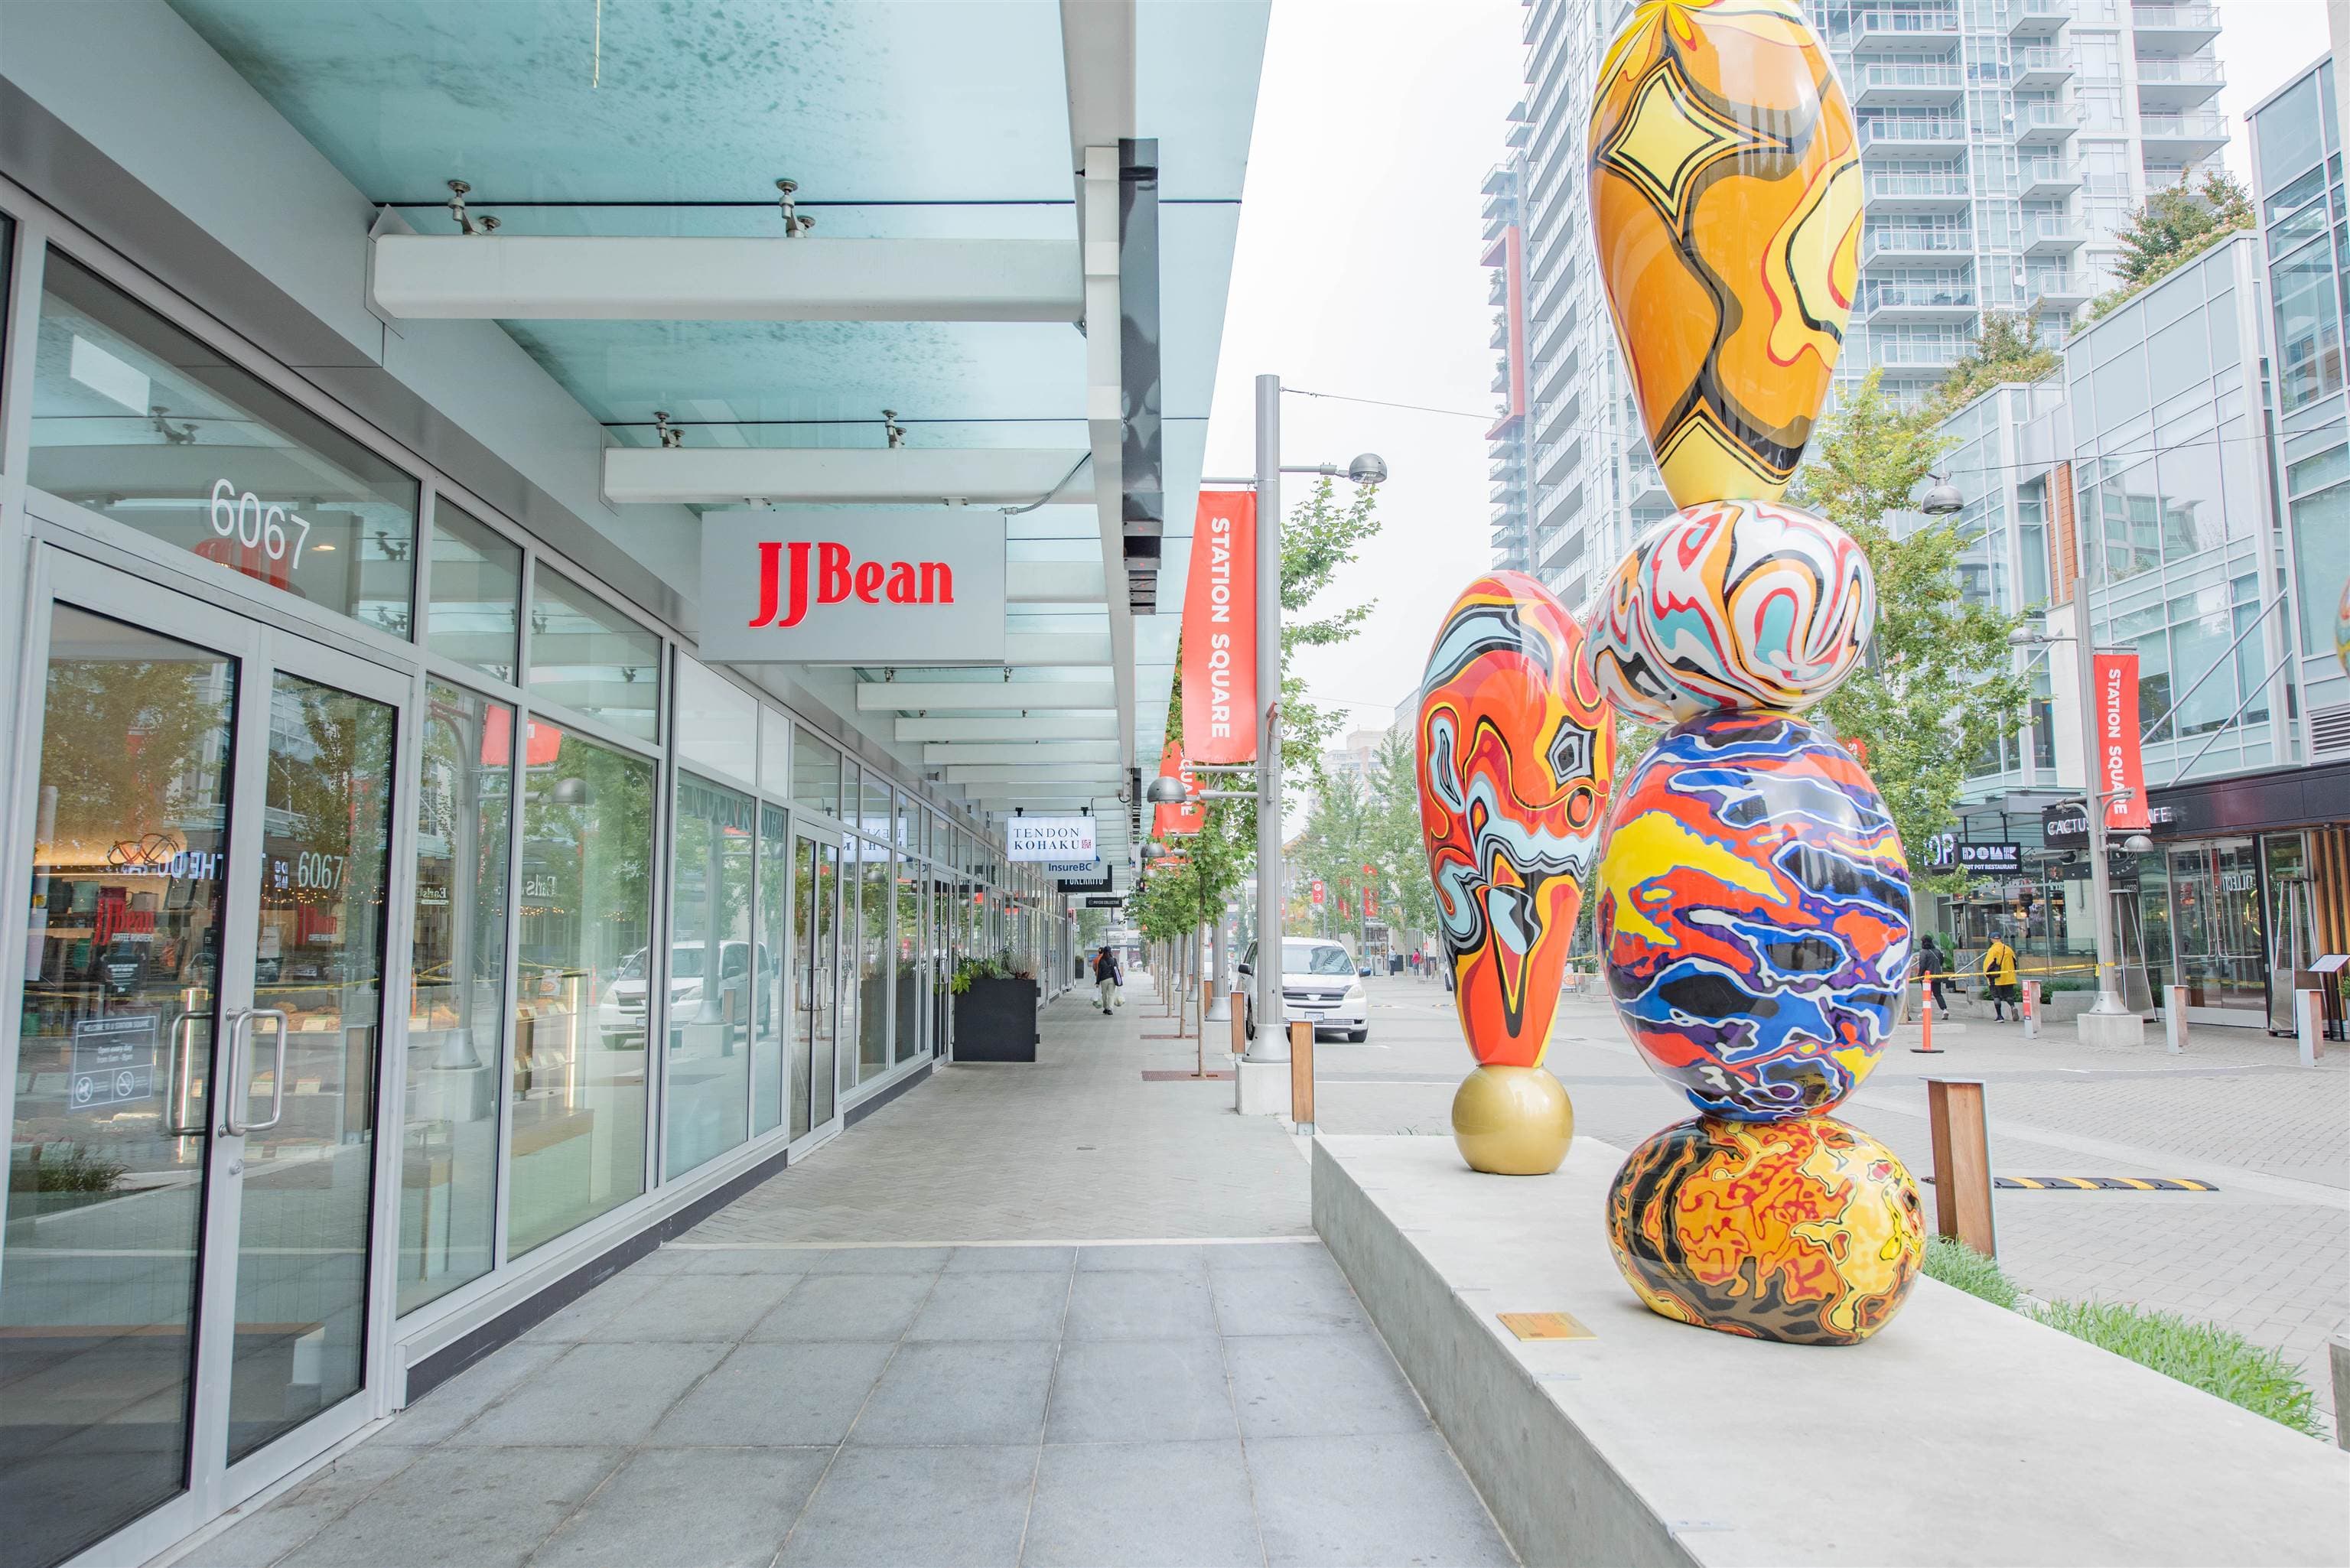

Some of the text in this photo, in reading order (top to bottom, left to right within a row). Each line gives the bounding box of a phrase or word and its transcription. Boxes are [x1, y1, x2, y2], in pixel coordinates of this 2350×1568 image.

[211, 478, 311, 570] 6067
[1207, 516, 1230, 738] STATION SQUARE
[2108, 668, 2121, 738] STATION
[2148, 807, 2169, 824] AFE
[1014, 828, 1079, 838] TENDON
[2047, 818, 2090, 836] CACTU
[1014, 840, 1079, 850] KOHAKU
[298, 851, 343, 890] 6067
[1048, 863, 1092, 872] InsureBC
